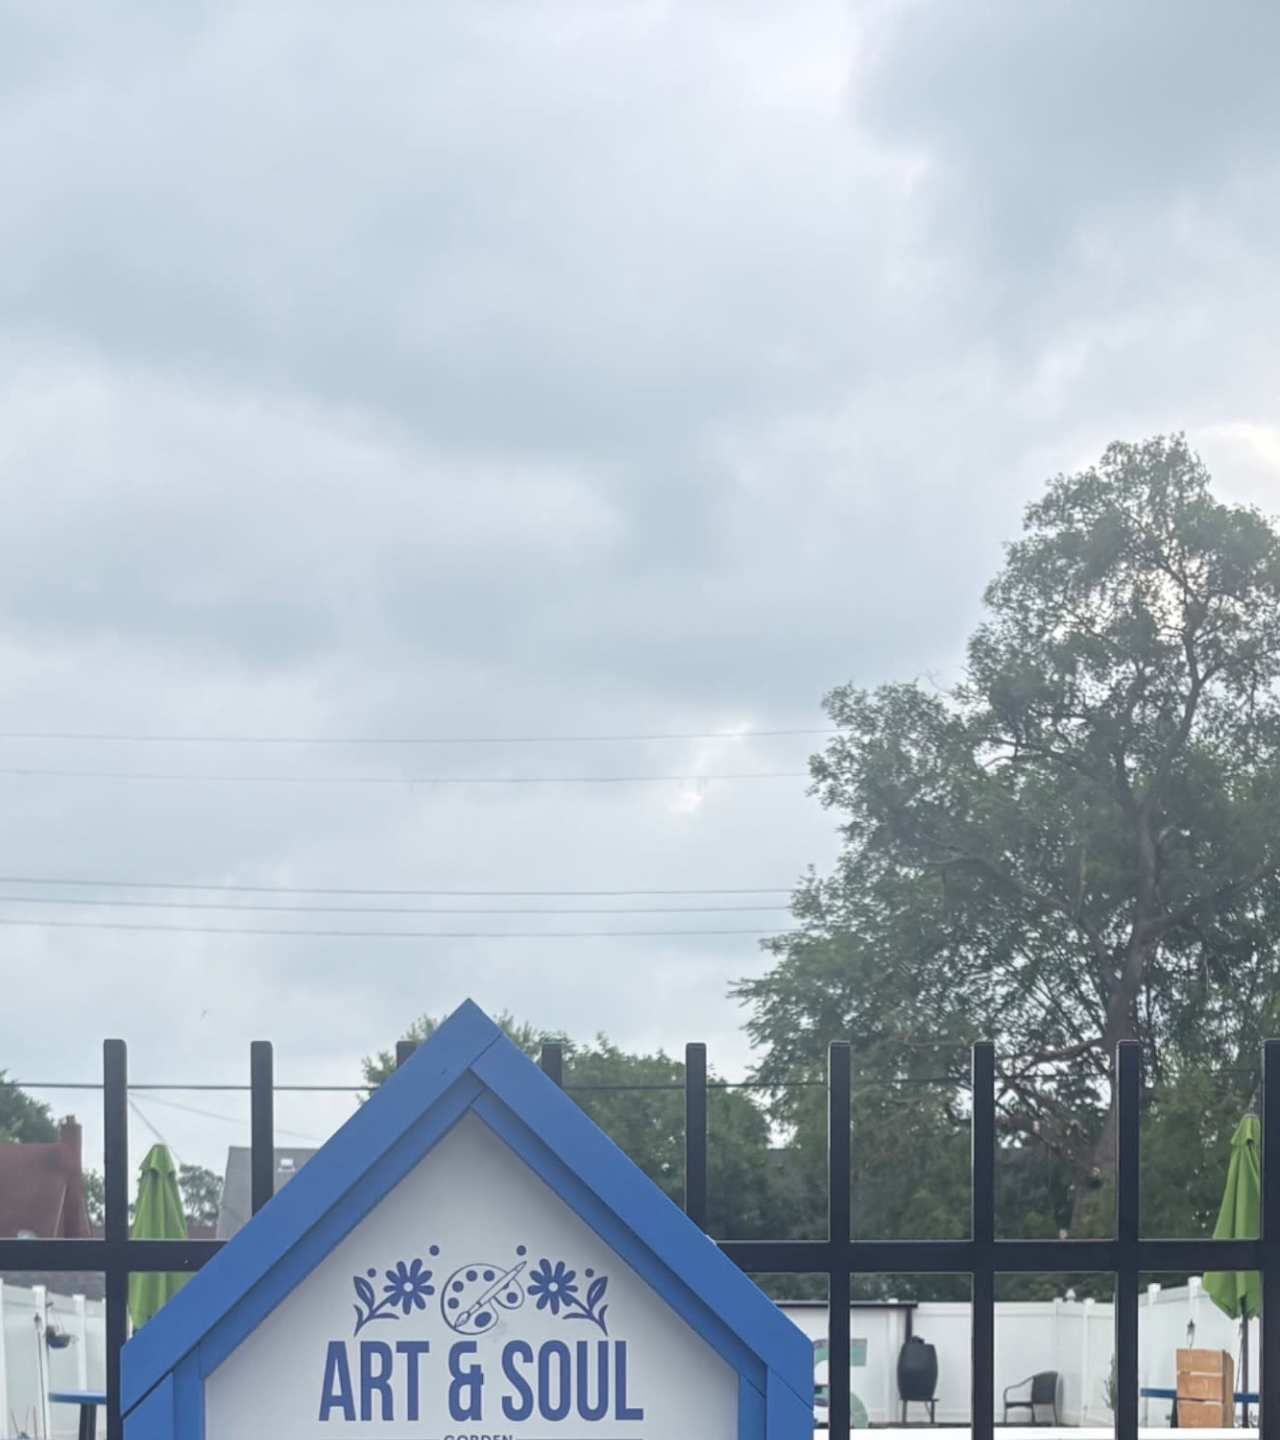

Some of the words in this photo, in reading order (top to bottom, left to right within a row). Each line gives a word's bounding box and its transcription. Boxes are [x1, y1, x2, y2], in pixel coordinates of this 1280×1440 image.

[318, 1340, 430, 1422] ART
[448, 1339, 484, 1422] &
[501, 1339, 644, 1422] SOUL
